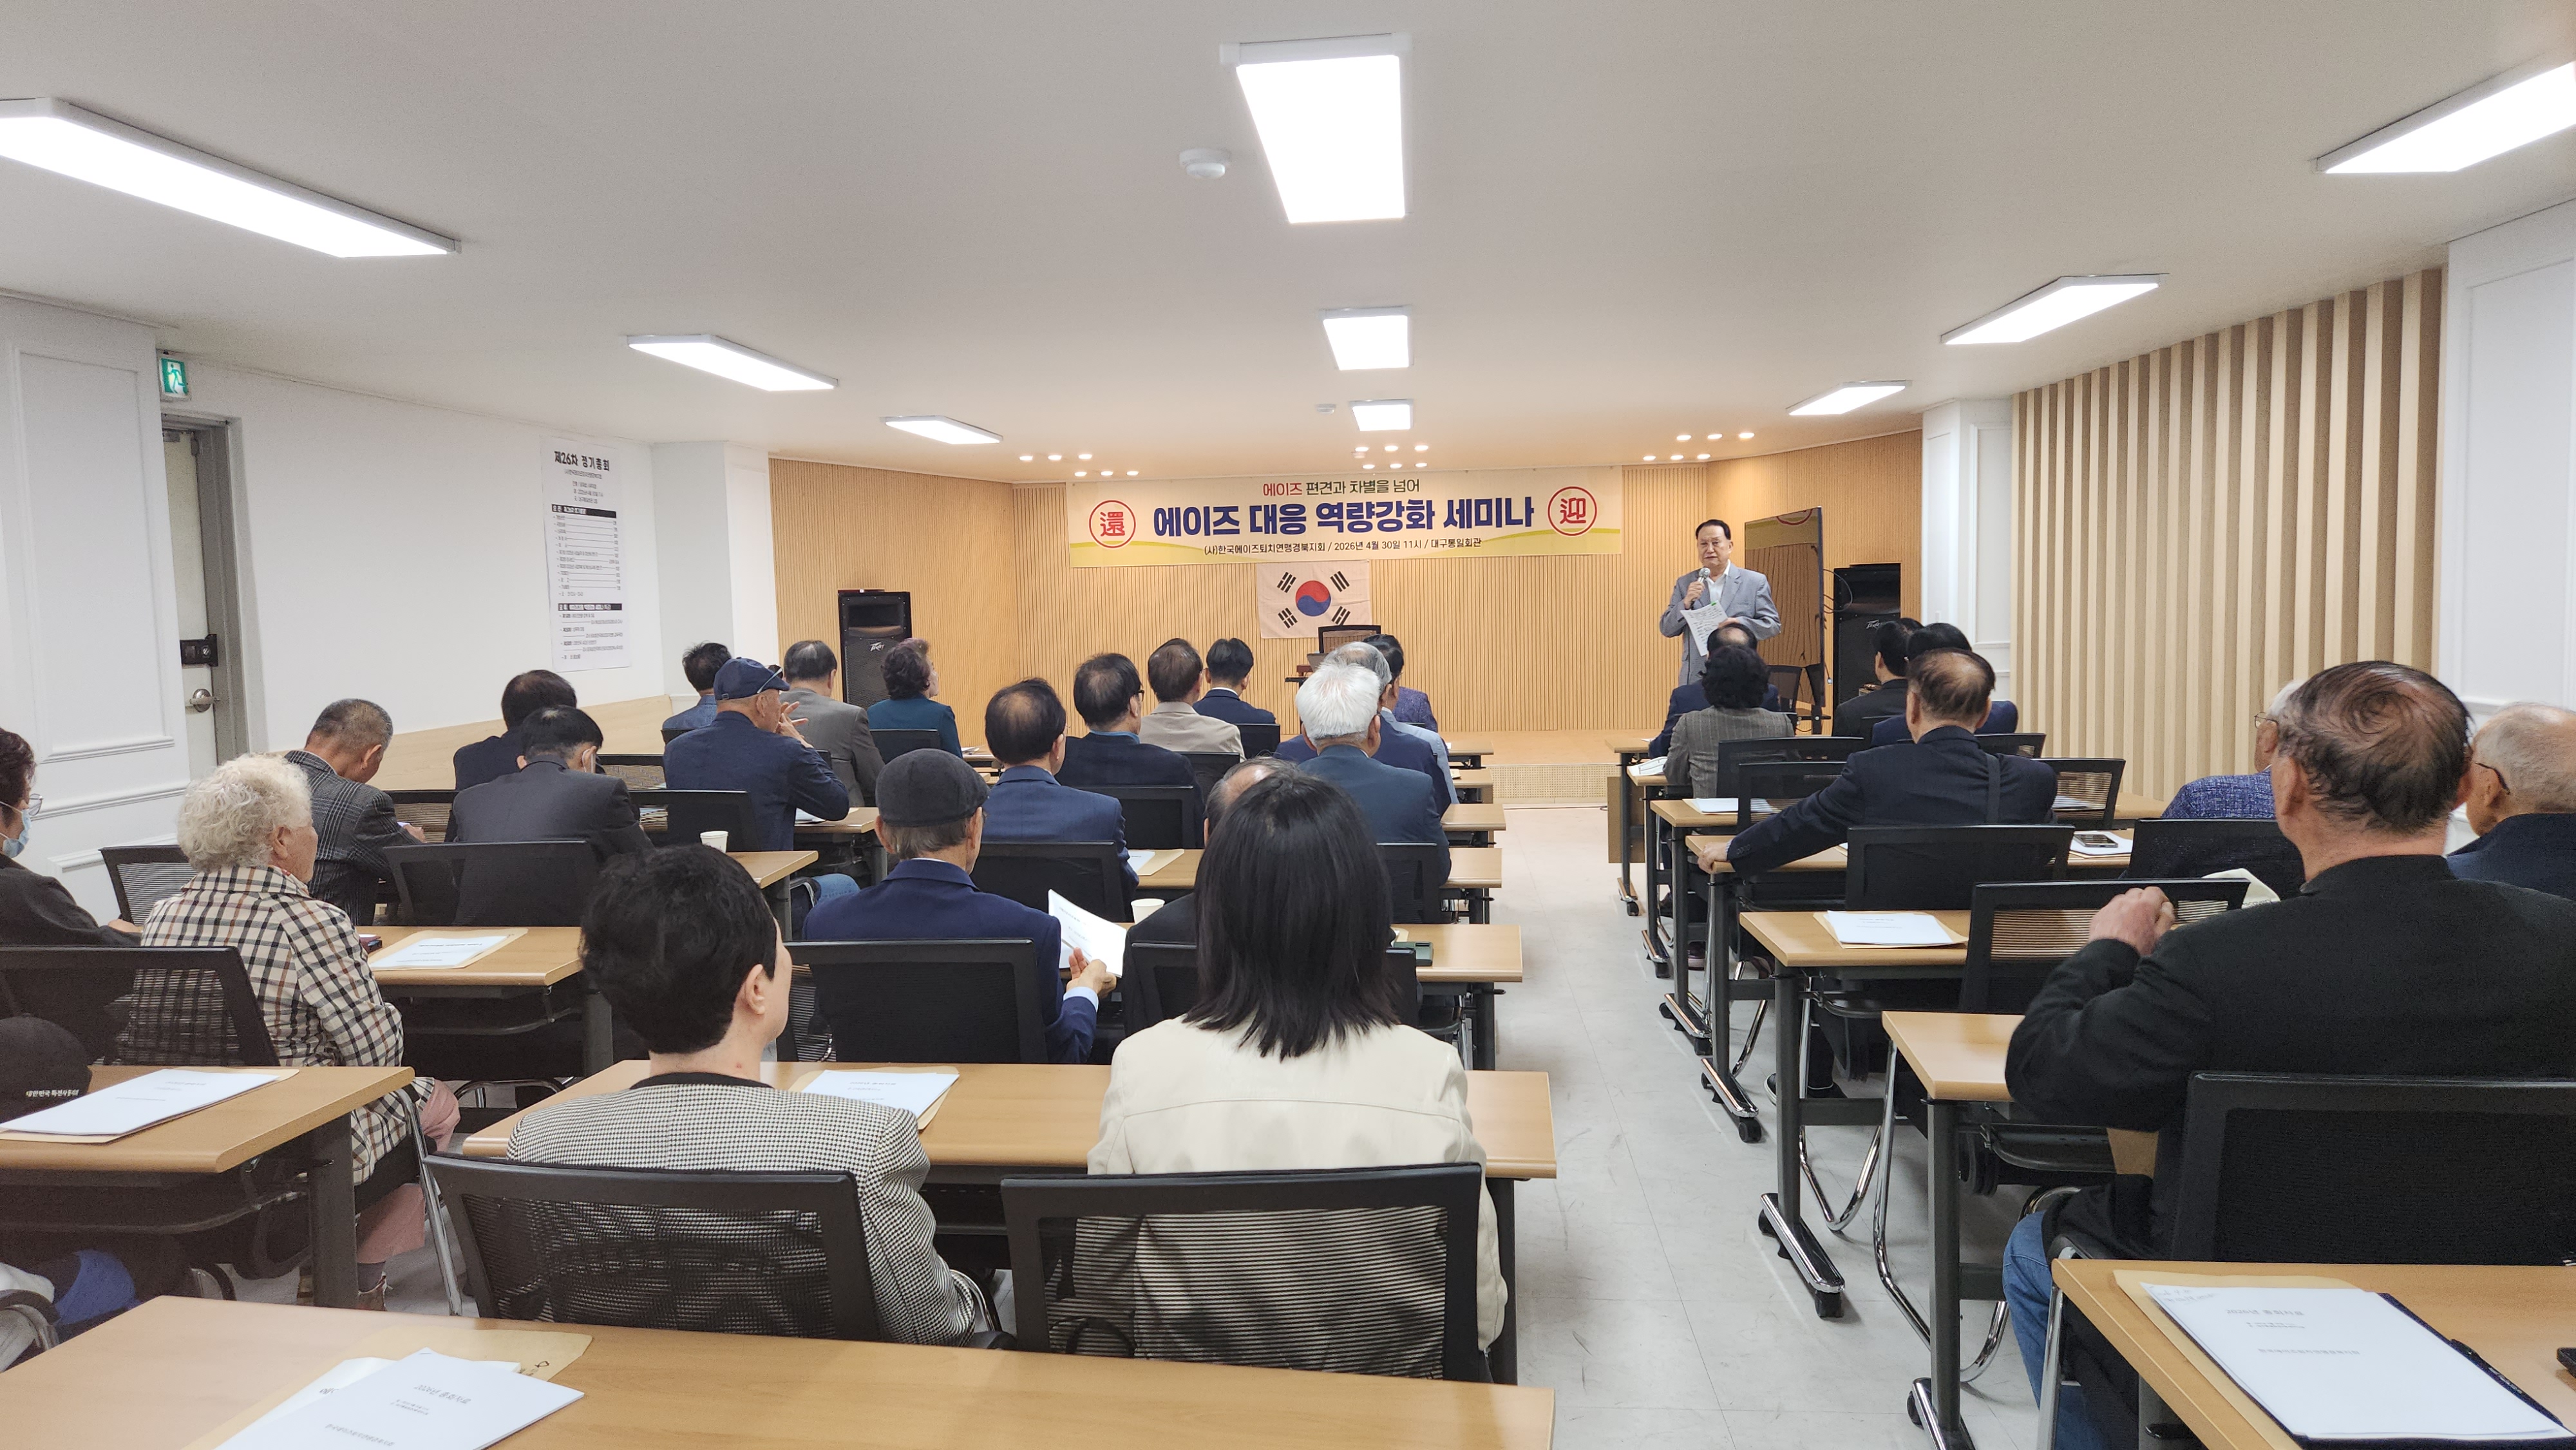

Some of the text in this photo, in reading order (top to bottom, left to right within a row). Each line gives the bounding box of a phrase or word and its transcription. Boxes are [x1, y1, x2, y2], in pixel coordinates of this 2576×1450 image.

[554, 451, 610, 471] 제26차 정기총회
[1263, 478, 1419, 496] 에이즈 편견과 차별을 넘어
[1153, 496, 1535, 537] 에이즈 대응 역량강화 세미나
[1559, 497, 1587, 525] 迎
[1100, 511, 1126, 537] 還
[1204, 542, 1325, 556] (사)한국에이즈퇴치연맹경북지회
[1327, 541, 1332, 552] /
[1334, 541, 1363, 551] 2026년
[1365, 540, 1379, 551] 4월
[1381, 540, 1401, 550] 30일
[1403, 539, 1421, 549] 11시
[1431, 537, 1482, 548] 대구통일회관
